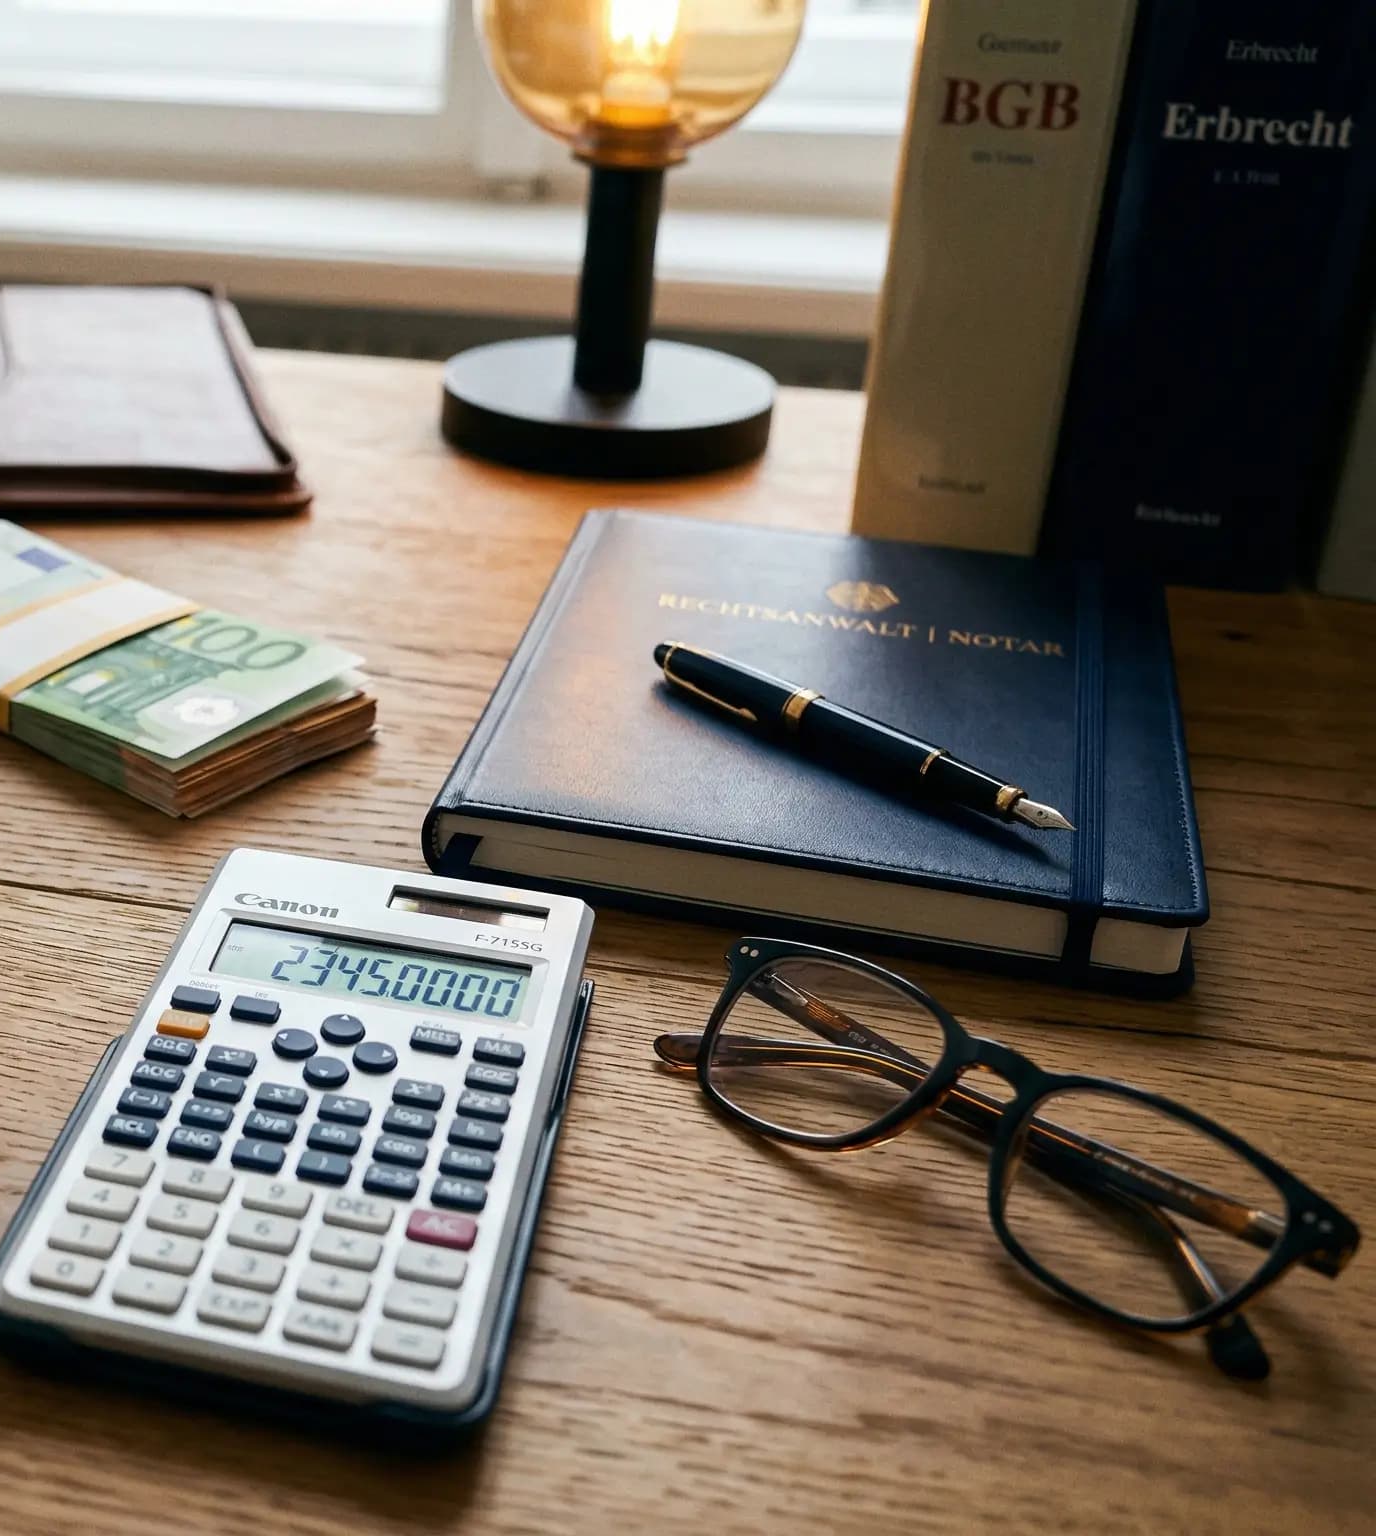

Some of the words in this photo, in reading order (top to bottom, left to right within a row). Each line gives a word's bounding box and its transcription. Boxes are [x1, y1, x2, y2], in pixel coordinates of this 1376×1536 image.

[939, 77, 1081, 131] BGB
[1162, 102, 1354, 148] Erbrecht
[658, 592, 919, 639] RECHTSANWALT
[947, 628, 1065, 657] NOTAR
[234, 892, 340, 919] Canon
[112, 1152, 129, 1167] 7
[189, 1169, 206, 1184] 8
[93, 1188, 111, 1202] 4
[269, 1182, 285, 1199] 9
[172, 1203, 188, 1220] 5
[254, 1219, 271, 1237] 6
[157, 1238, 175, 1257] 2
[56, 1260, 75, 1276] 0
